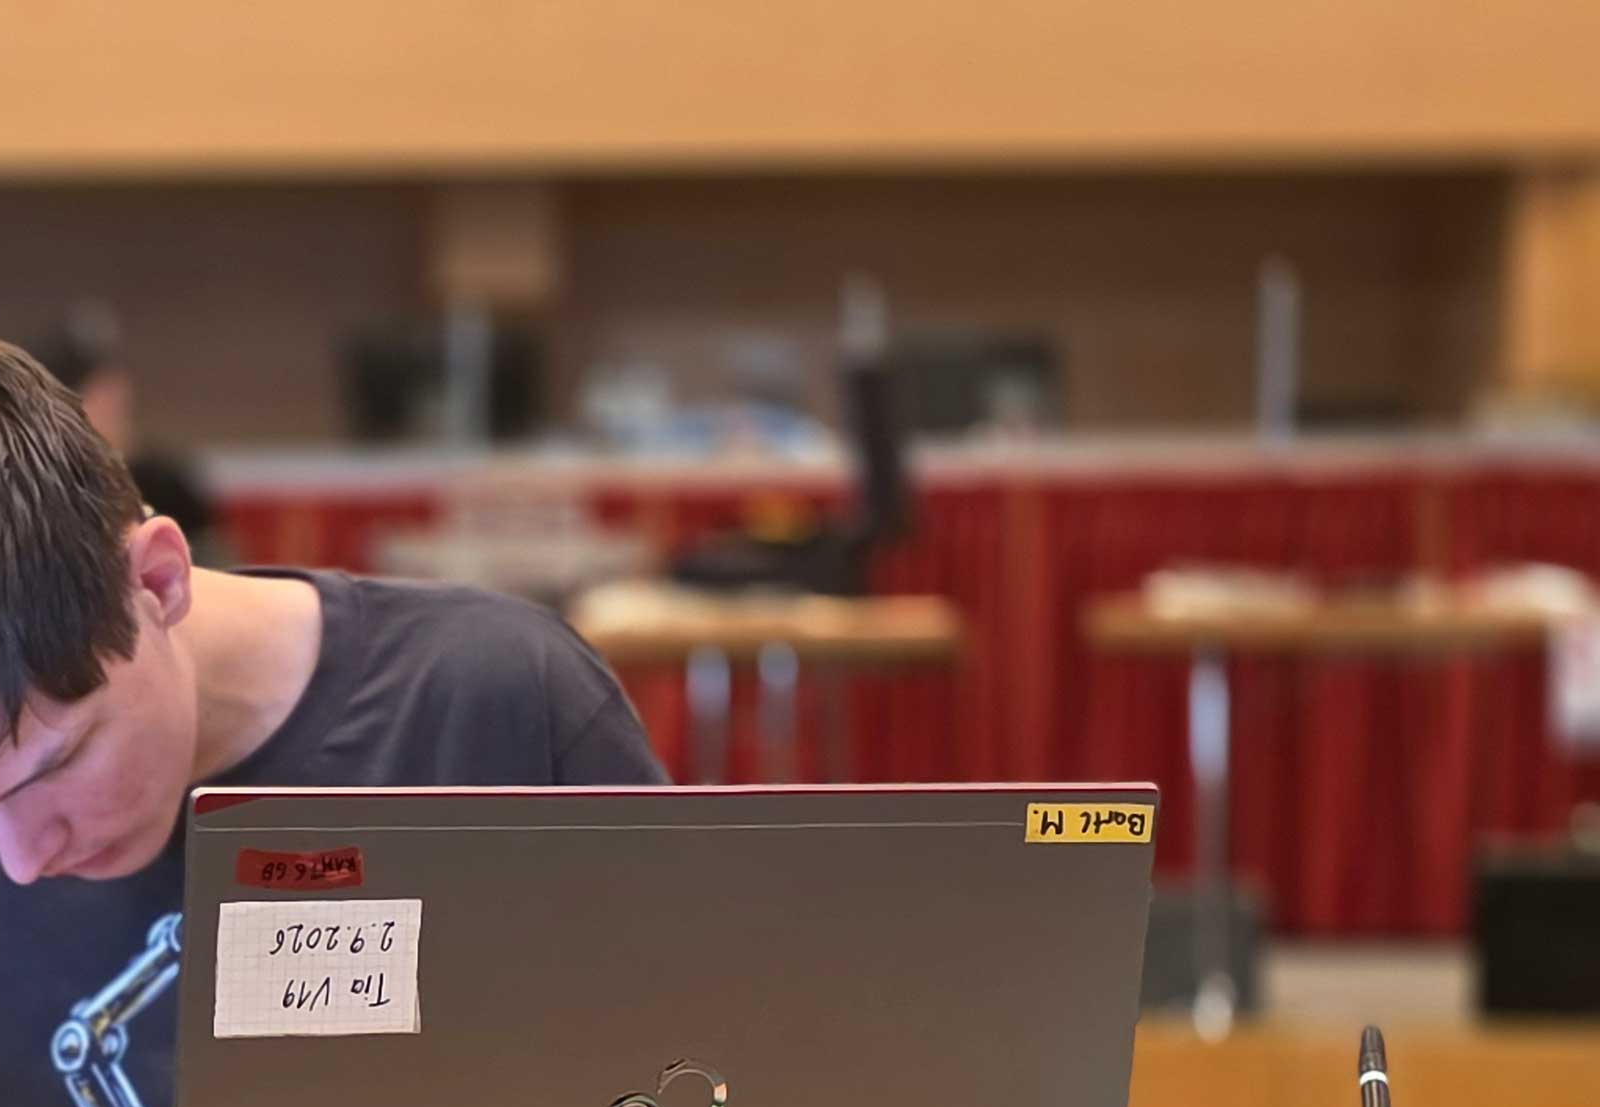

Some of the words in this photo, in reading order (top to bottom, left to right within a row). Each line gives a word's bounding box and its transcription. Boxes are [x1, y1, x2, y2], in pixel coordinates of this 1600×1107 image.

[1033, 810, 1063, 836] M.
[270, 921, 395, 955] 2.9.2026
[282, 976, 331, 1012] V19
[350, 973, 392, 1007] Tia
